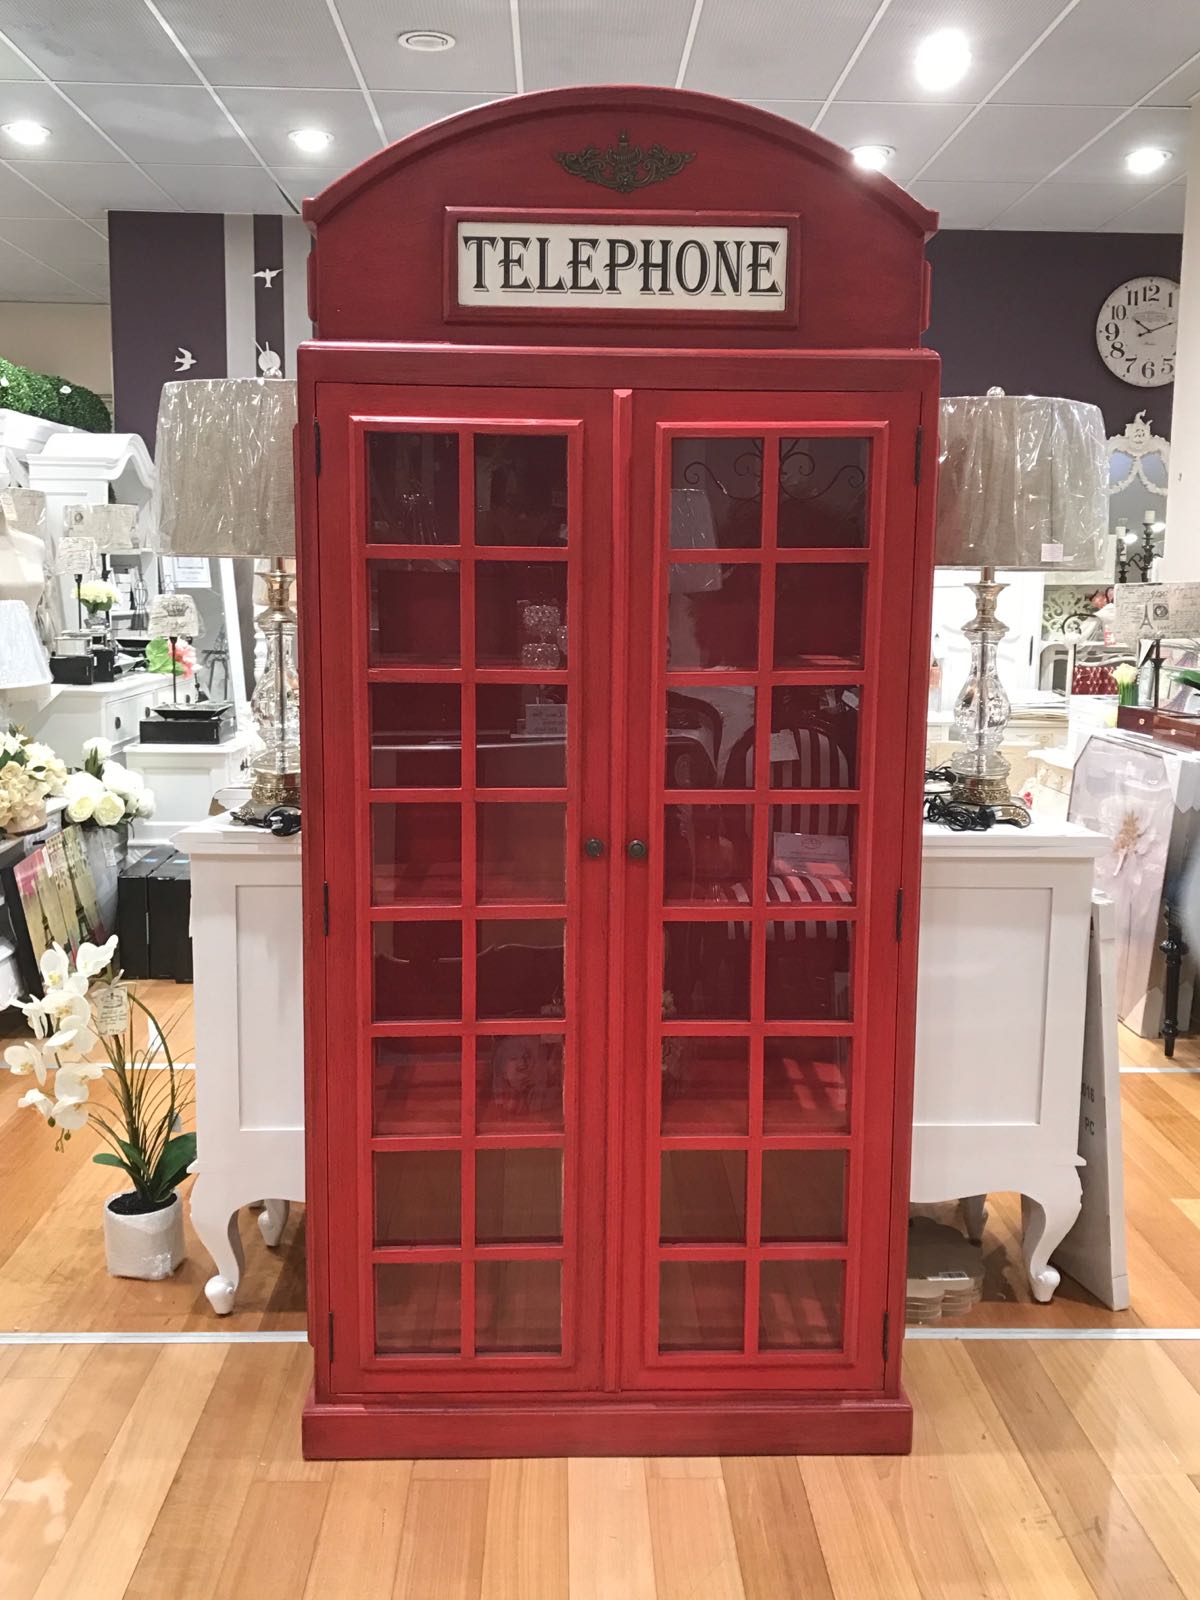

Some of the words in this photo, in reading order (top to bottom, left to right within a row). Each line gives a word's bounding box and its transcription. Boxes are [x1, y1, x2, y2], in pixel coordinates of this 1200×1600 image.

[462, 235, 783, 297] TELEPHONE
[1127, 290, 1139, 306] 11
[1142, 284, 1160, 302] 12
[1168, 292, 1173, 308] 1
[1111, 304, 1127, 320] 10
[1104, 321, 1120, 341] 9
[1110, 341, 1125, 359] 8
[1125, 357, 1138, 373] 7
[1141, 360, 1155, 379] 6
[1160, 358, 1174, 374] 5
